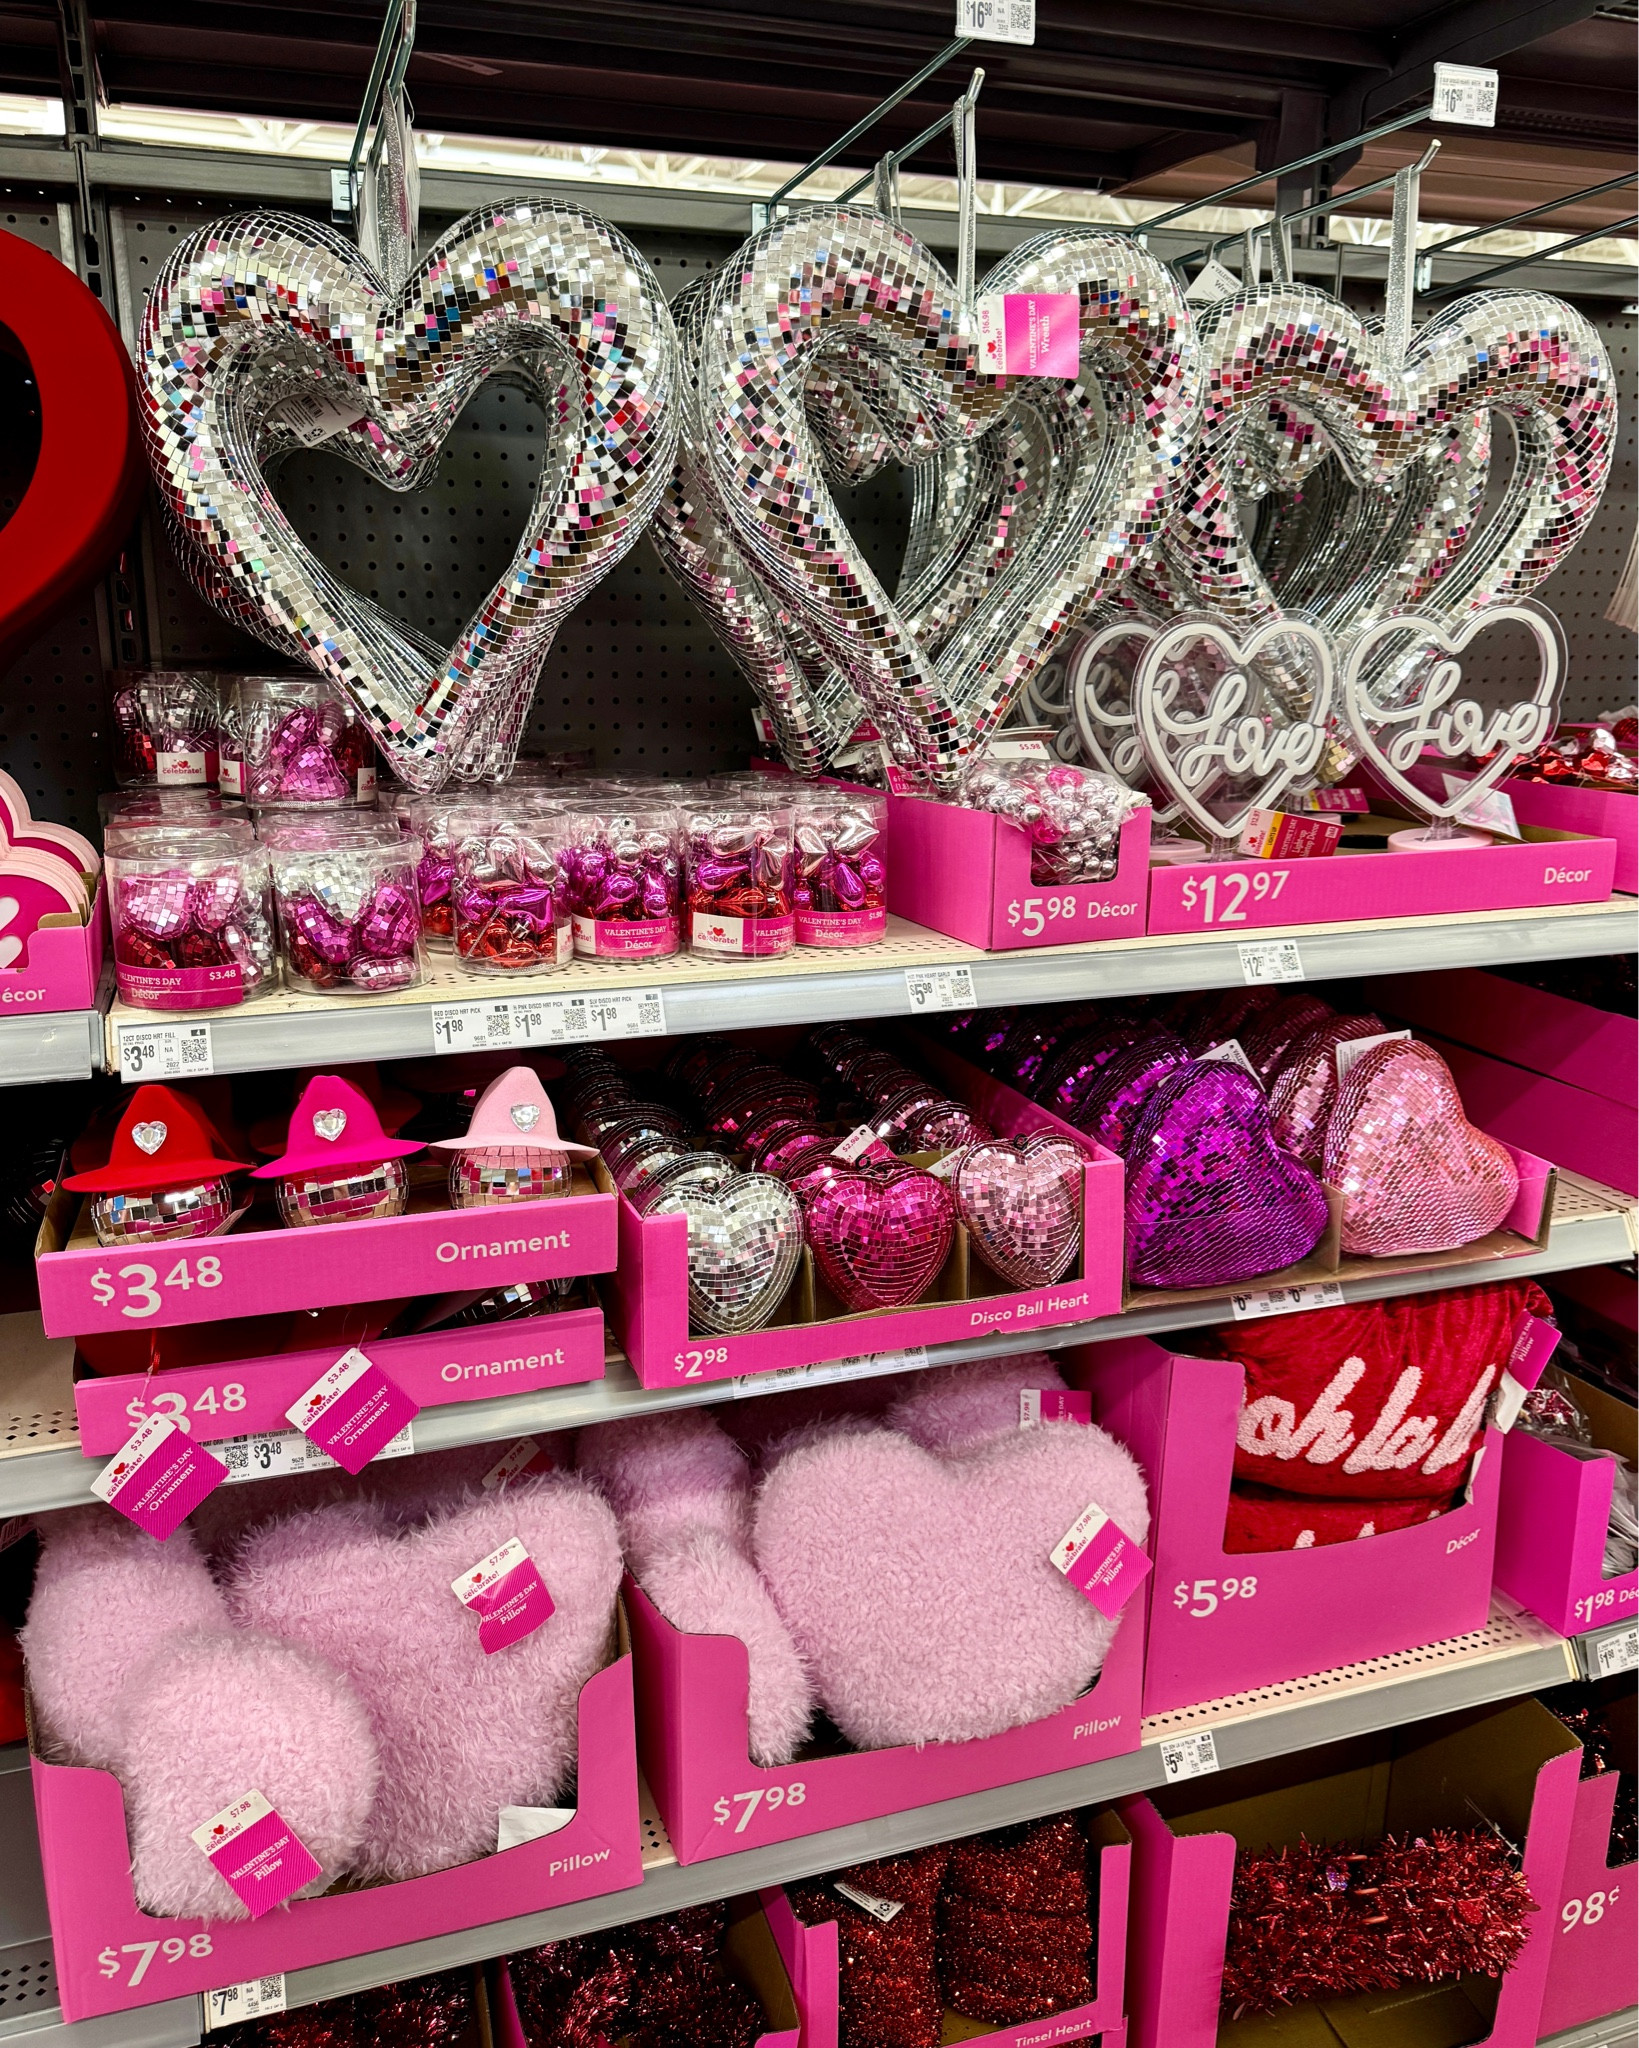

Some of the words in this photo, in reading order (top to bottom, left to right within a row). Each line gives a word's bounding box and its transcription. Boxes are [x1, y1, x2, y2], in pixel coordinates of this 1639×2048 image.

[1028, 300, 1036, 316] DAY
[982, 310, 990, 334] $16.98
[1040, 316, 1050, 354] Wreath
[1029, 316, 1037, 370] VALENTINE'S
[1357, 661, 1551, 771] Love
[1153, 672, 1326, 788] Love
[162, 767, 202, 775] celebrate!
[1544, 866, 1592, 885] Décor
[798, 916, 847, 927] VALENTINE'S
[848, 917, 862, 925] DAY
[1087, 900, 1138, 919] Décor
[604, 927, 654, 937] VALENTINE'S
[654, 925, 667, 934] DAY
[624, 939, 653, 949] Décor
[815, 929, 844, 939] Décor
[162, 977, 182, 986] DAY
[209, 969, 237, 981] $3.48
[0, 988, 47, 1003] écor
[131, 986, 160, 1000] Décor
[842, 1135, 860, 1152] $2.98
[436, 1229, 571, 1264] Ornament
[970, 1305, 1012, 1326] Disco
[1015, 1300, 1044, 1321] Ball
[1046, 1292, 1090, 1317] Heart
[327, 1362, 350, 1385] $3.48
[441, 1347, 566, 1383] Ornament
[302, 1387, 342, 1427] celebrate!
[327, 1400, 374, 1446] VALENTINE'S
[373, 1385, 389, 1403] DAY
[344, 1400, 391, 1446] Ornament
[130, 1427, 153, 1452] $3.48
[107, 1453, 145, 1497] celebrate!
[132, 1463, 179, 1513] VALENTINE'S
[178, 1447, 194, 1466] DAY
[149, 1463, 197, 1511] Ornament
[1076, 1514, 1092, 1533] $7.98
[1062, 1536, 1088, 1570] celebrate!
[1446, 1528, 1481, 1554] Décor
[489, 1548, 510, 1566] $7.98
[1084, 1550, 1117, 1590] VALENTINE'S
[1114, 1538, 1126, 1553] DAY
[463, 1570, 500, 1600] celebrate!
[1102, 1560, 1124, 1586] Pillow
[482, 1592, 525, 1622] VALENTINE'S
[523, 1580, 538, 1595] DAY
[500, 1603, 527, 1625] Pillow
[1073, 1714, 1123, 1740] Pillow
[230, 1800, 251, 1818] $7.98
[206, 1822, 244, 1852] celebrate!
[230, 1846, 276, 1880] VALENTINE'S
[275, 1835, 290, 1851] DAY
[254, 1858, 283, 1881] Pillow
[549, 1848, 612, 1879] Pillow
[1015, 2029, 1052, 2047] Tinsel
[1056, 2019, 1092, 2037] Heart
